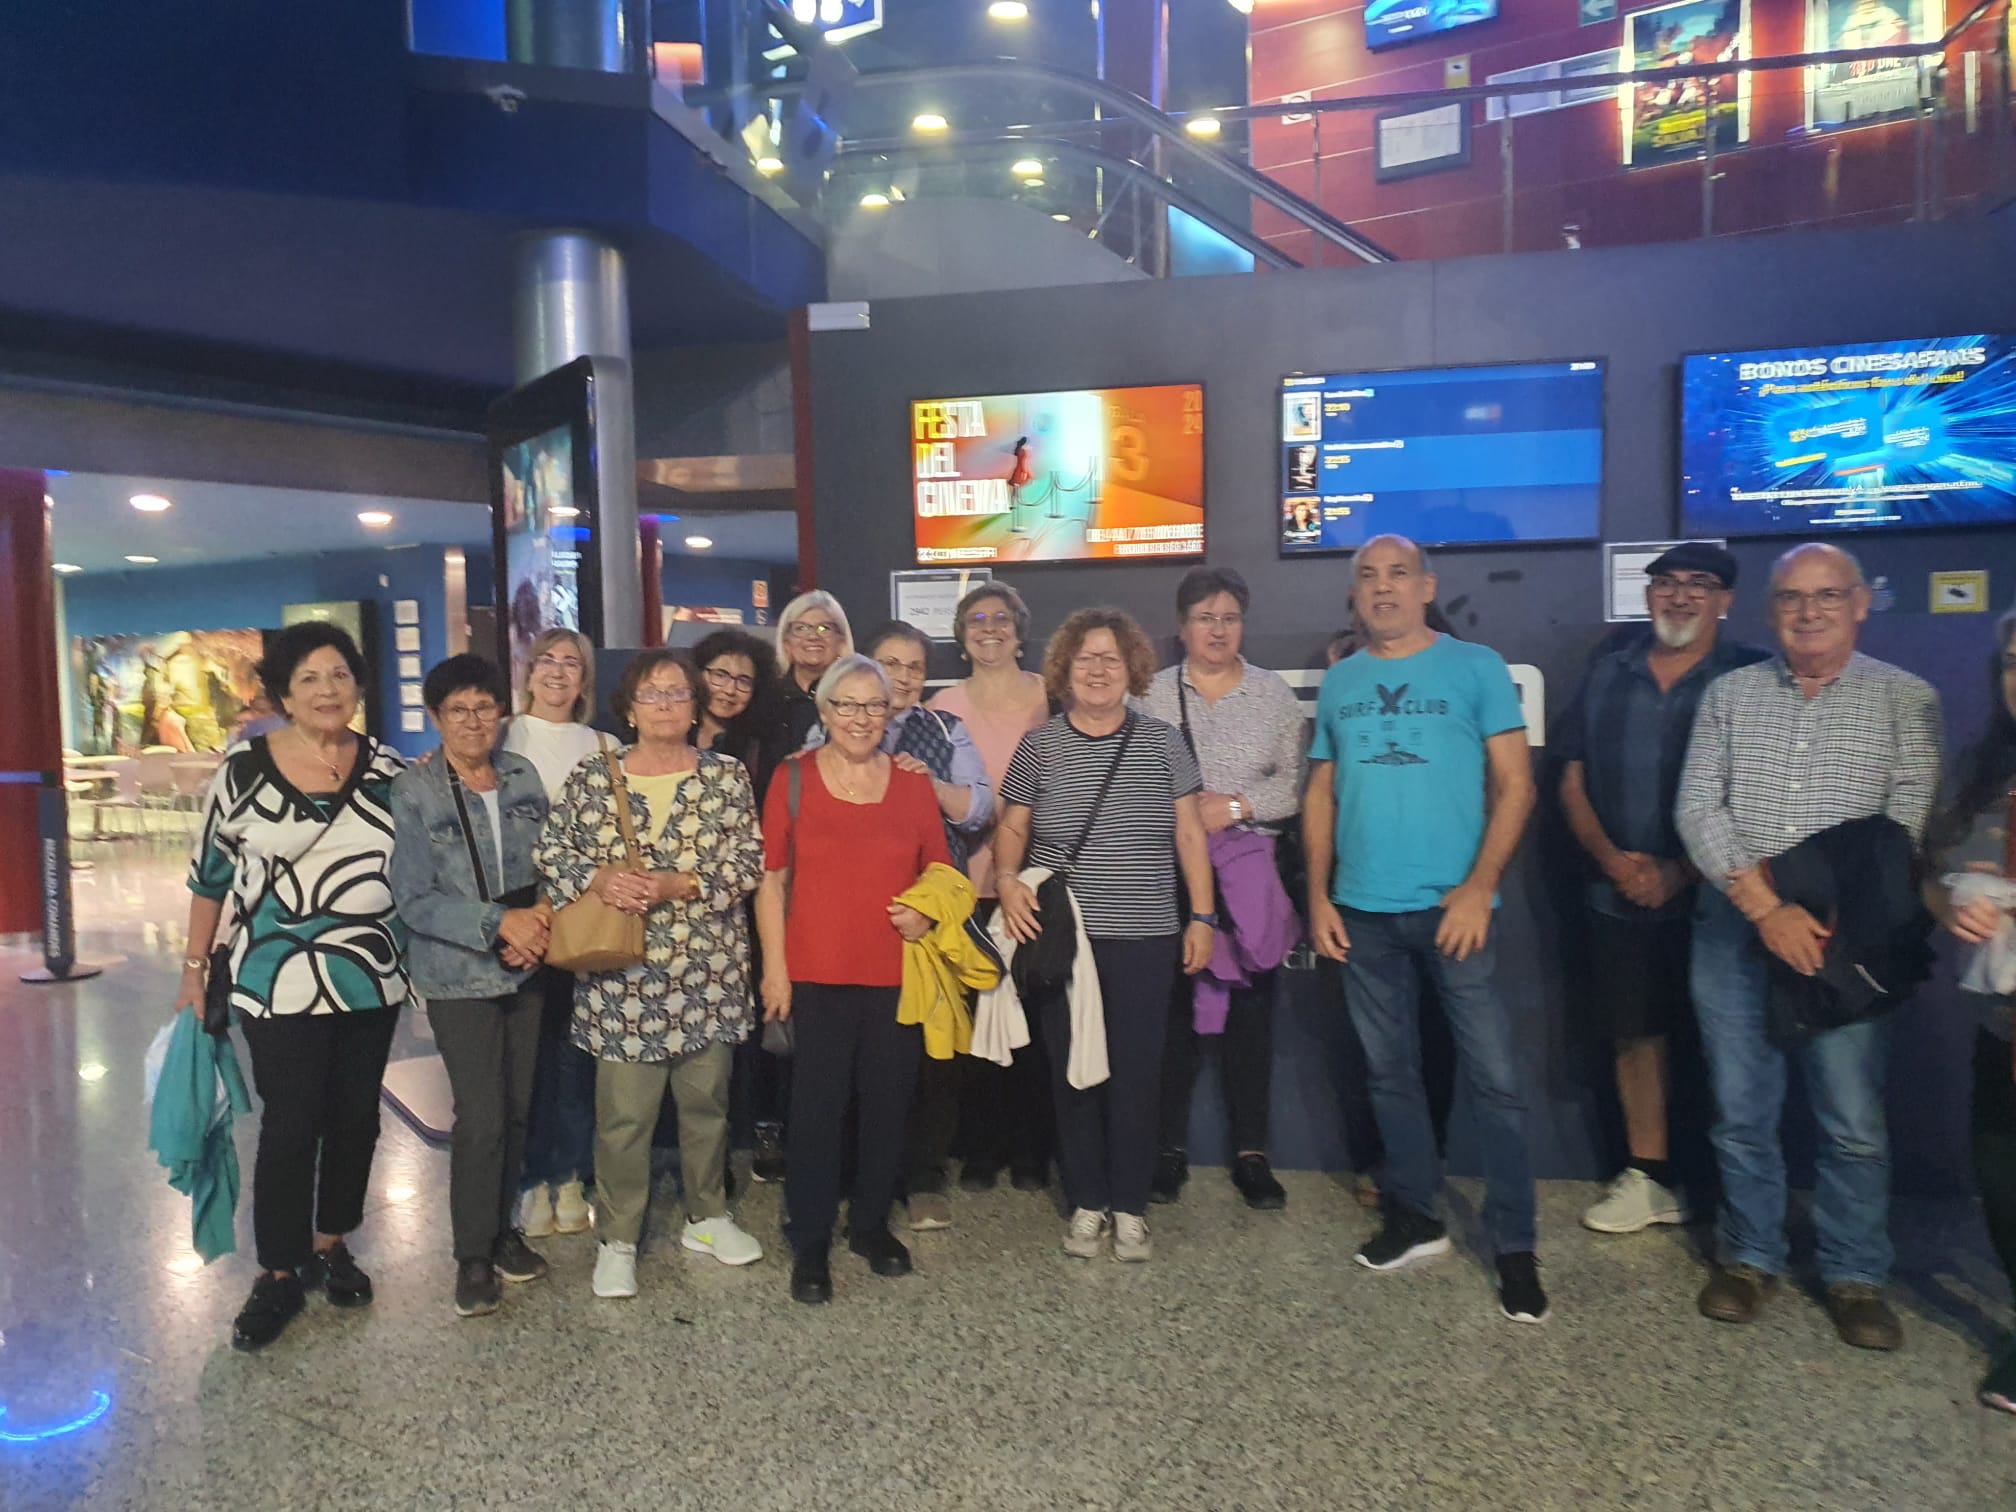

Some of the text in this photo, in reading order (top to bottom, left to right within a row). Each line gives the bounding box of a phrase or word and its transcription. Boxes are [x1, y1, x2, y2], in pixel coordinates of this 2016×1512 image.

[1739, 358, 1828, 380] BONOS
[915, 400, 987, 440] FESTA
[917, 478, 1012, 517] CINEMA
[1339, 699, 1449, 720] SURF CLUB
